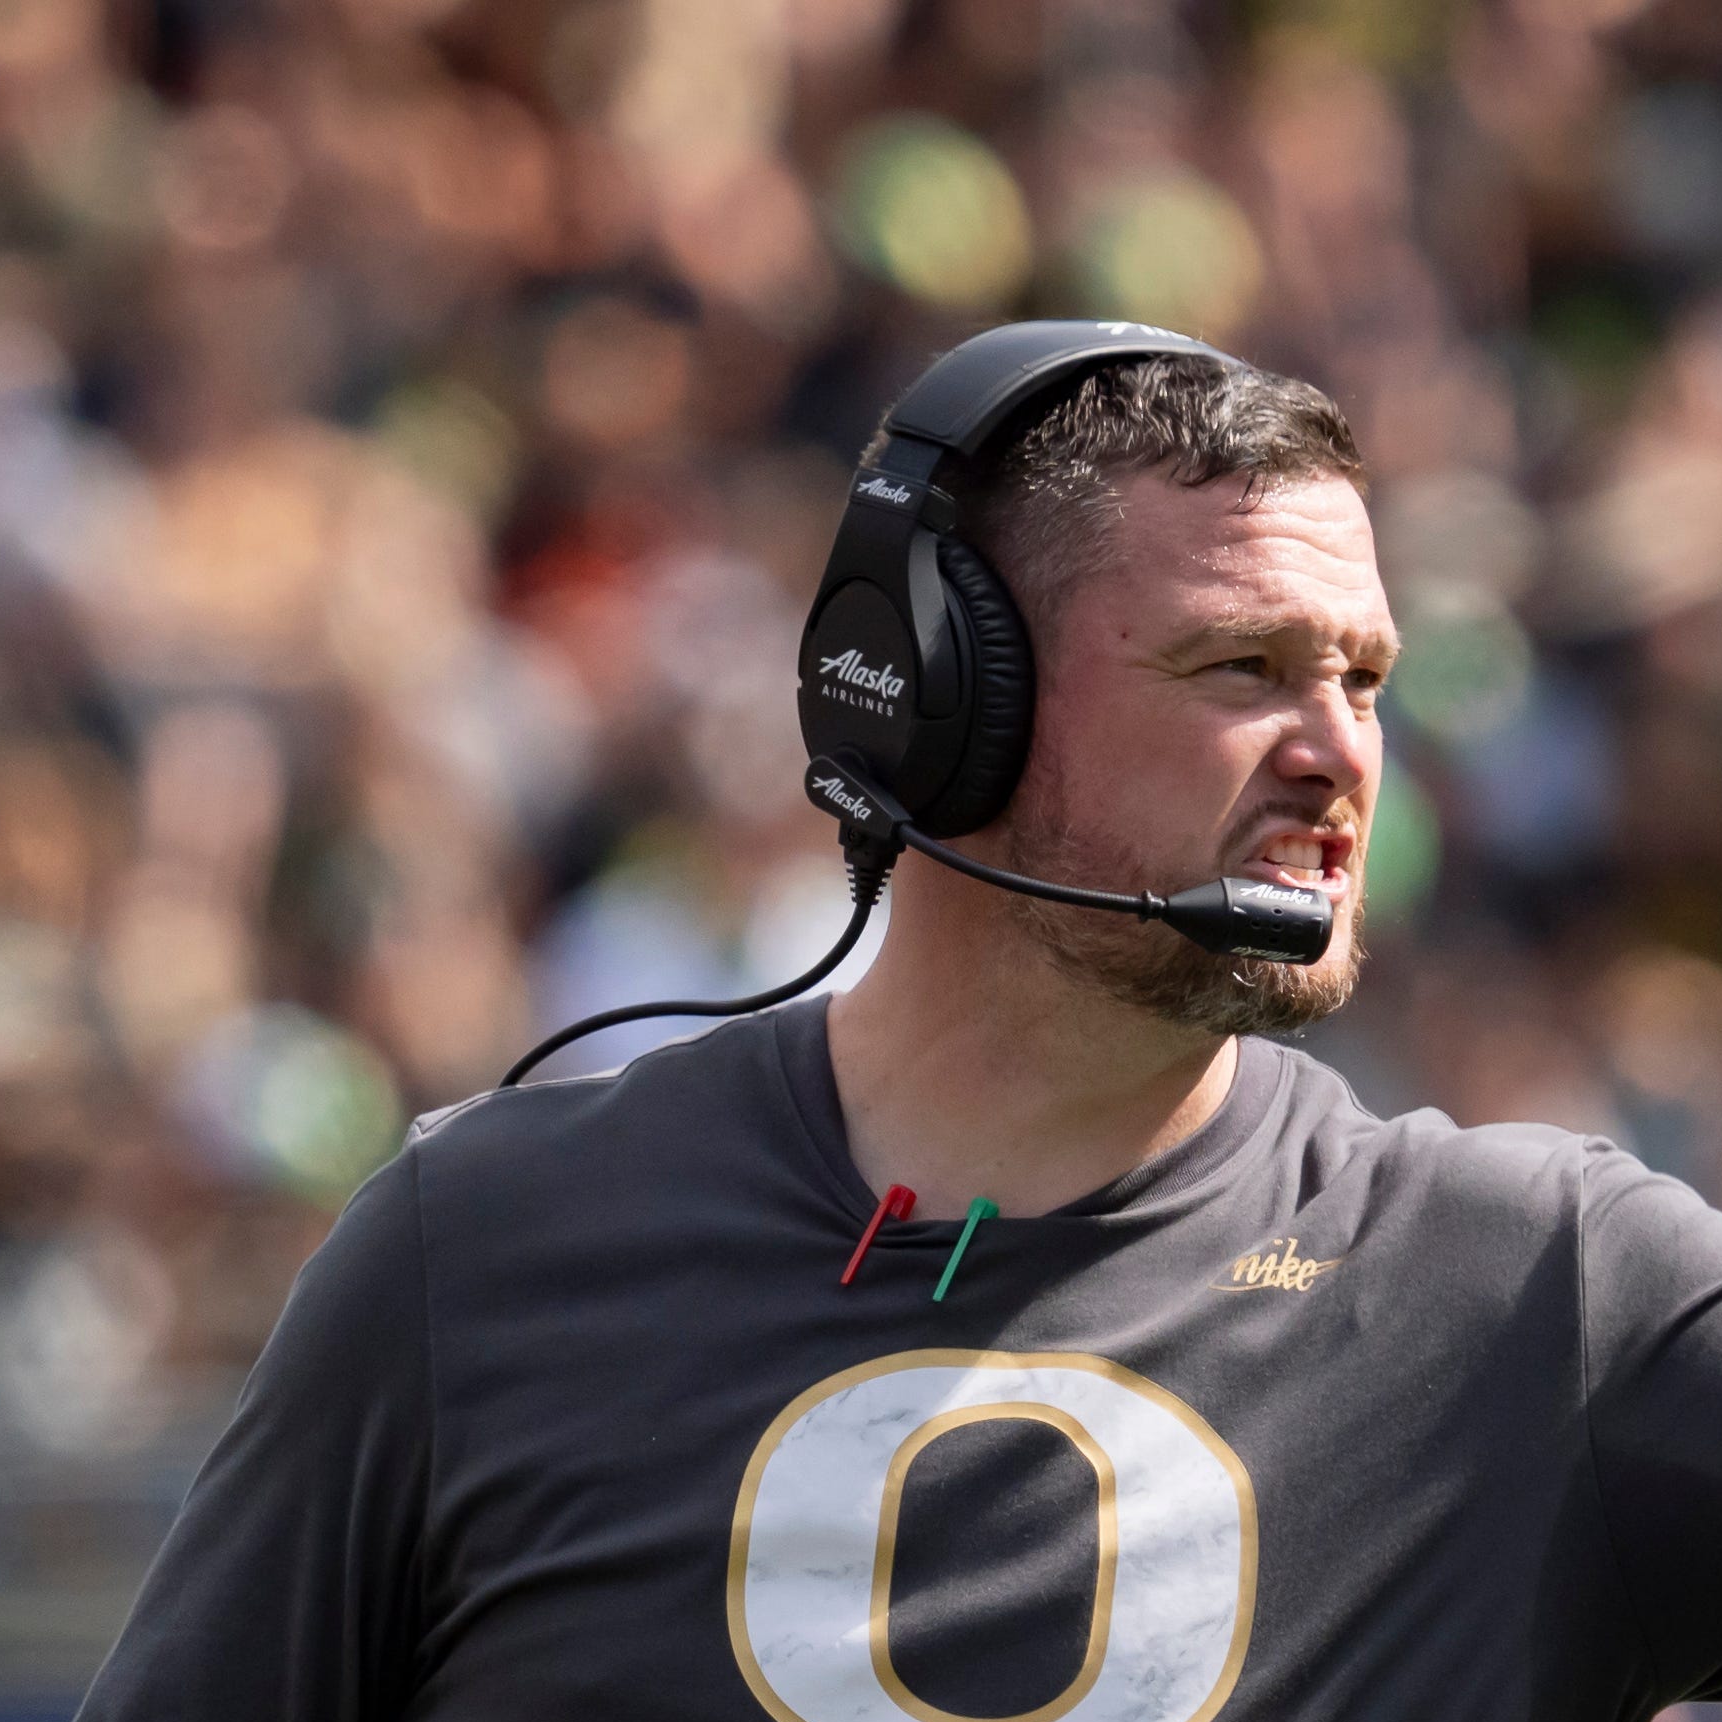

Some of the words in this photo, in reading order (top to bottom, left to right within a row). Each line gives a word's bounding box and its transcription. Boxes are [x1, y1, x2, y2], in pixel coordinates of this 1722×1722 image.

[857, 478, 911, 504] Alaska
[818, 649, 905, 699] Alaska
[821, 684, 894, 717] AIRLINES
[812, 776, 872, 821] Alaska
[1239, 883, 1314, 905] Alaska
